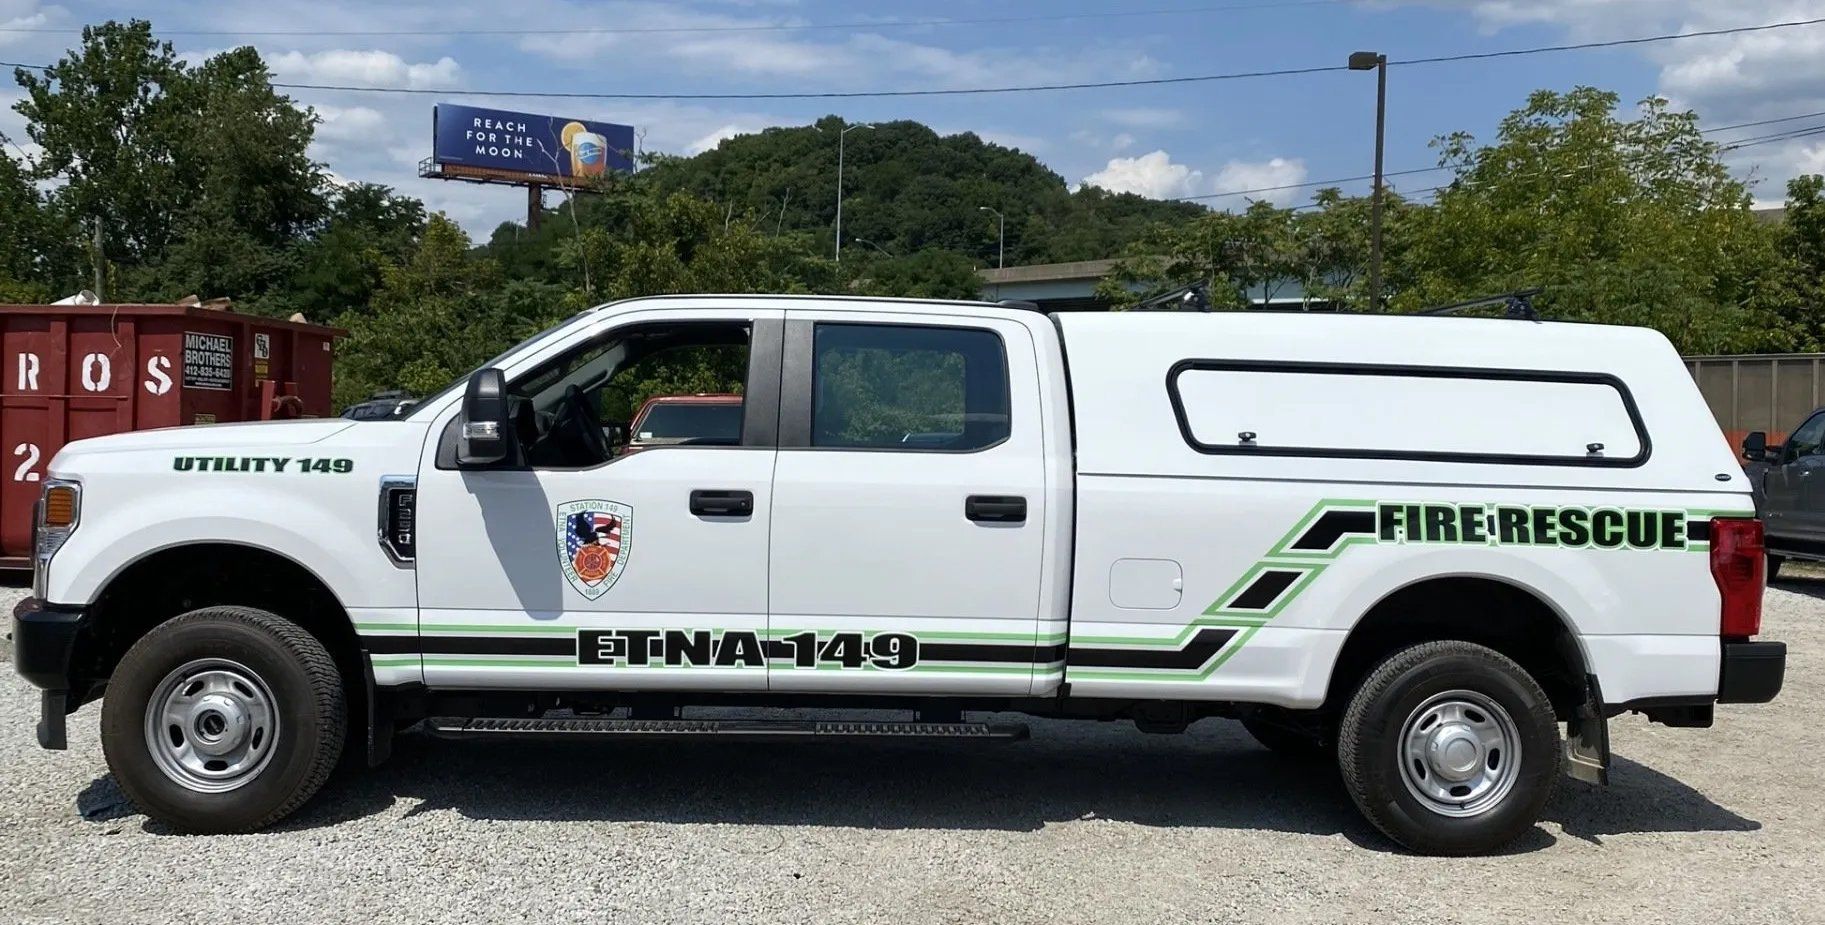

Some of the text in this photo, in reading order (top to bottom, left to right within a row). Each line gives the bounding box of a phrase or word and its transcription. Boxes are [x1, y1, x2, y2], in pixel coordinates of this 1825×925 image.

[474, 117, 526, 133] REACH
[466, 130, 533, 147] FOR THE
[475, 145, 523, 159] MOON
[185, 334, 231, 352] MICHAEL
[185, 350, 231, 367] BROTHERS
[14, 443, 40, 482] 2
[173, 457, 354, 473] UTILITY 149
[569, 501, 618, 512] STATION 149
[559, 512, 567, 532] ETNA
[1377, 501, 1688, 551] FIRE RESCUE
[603, 513, 631, 588] FIRE DEPARTMENT
[577, 628, 919, 671] ETNA 149
